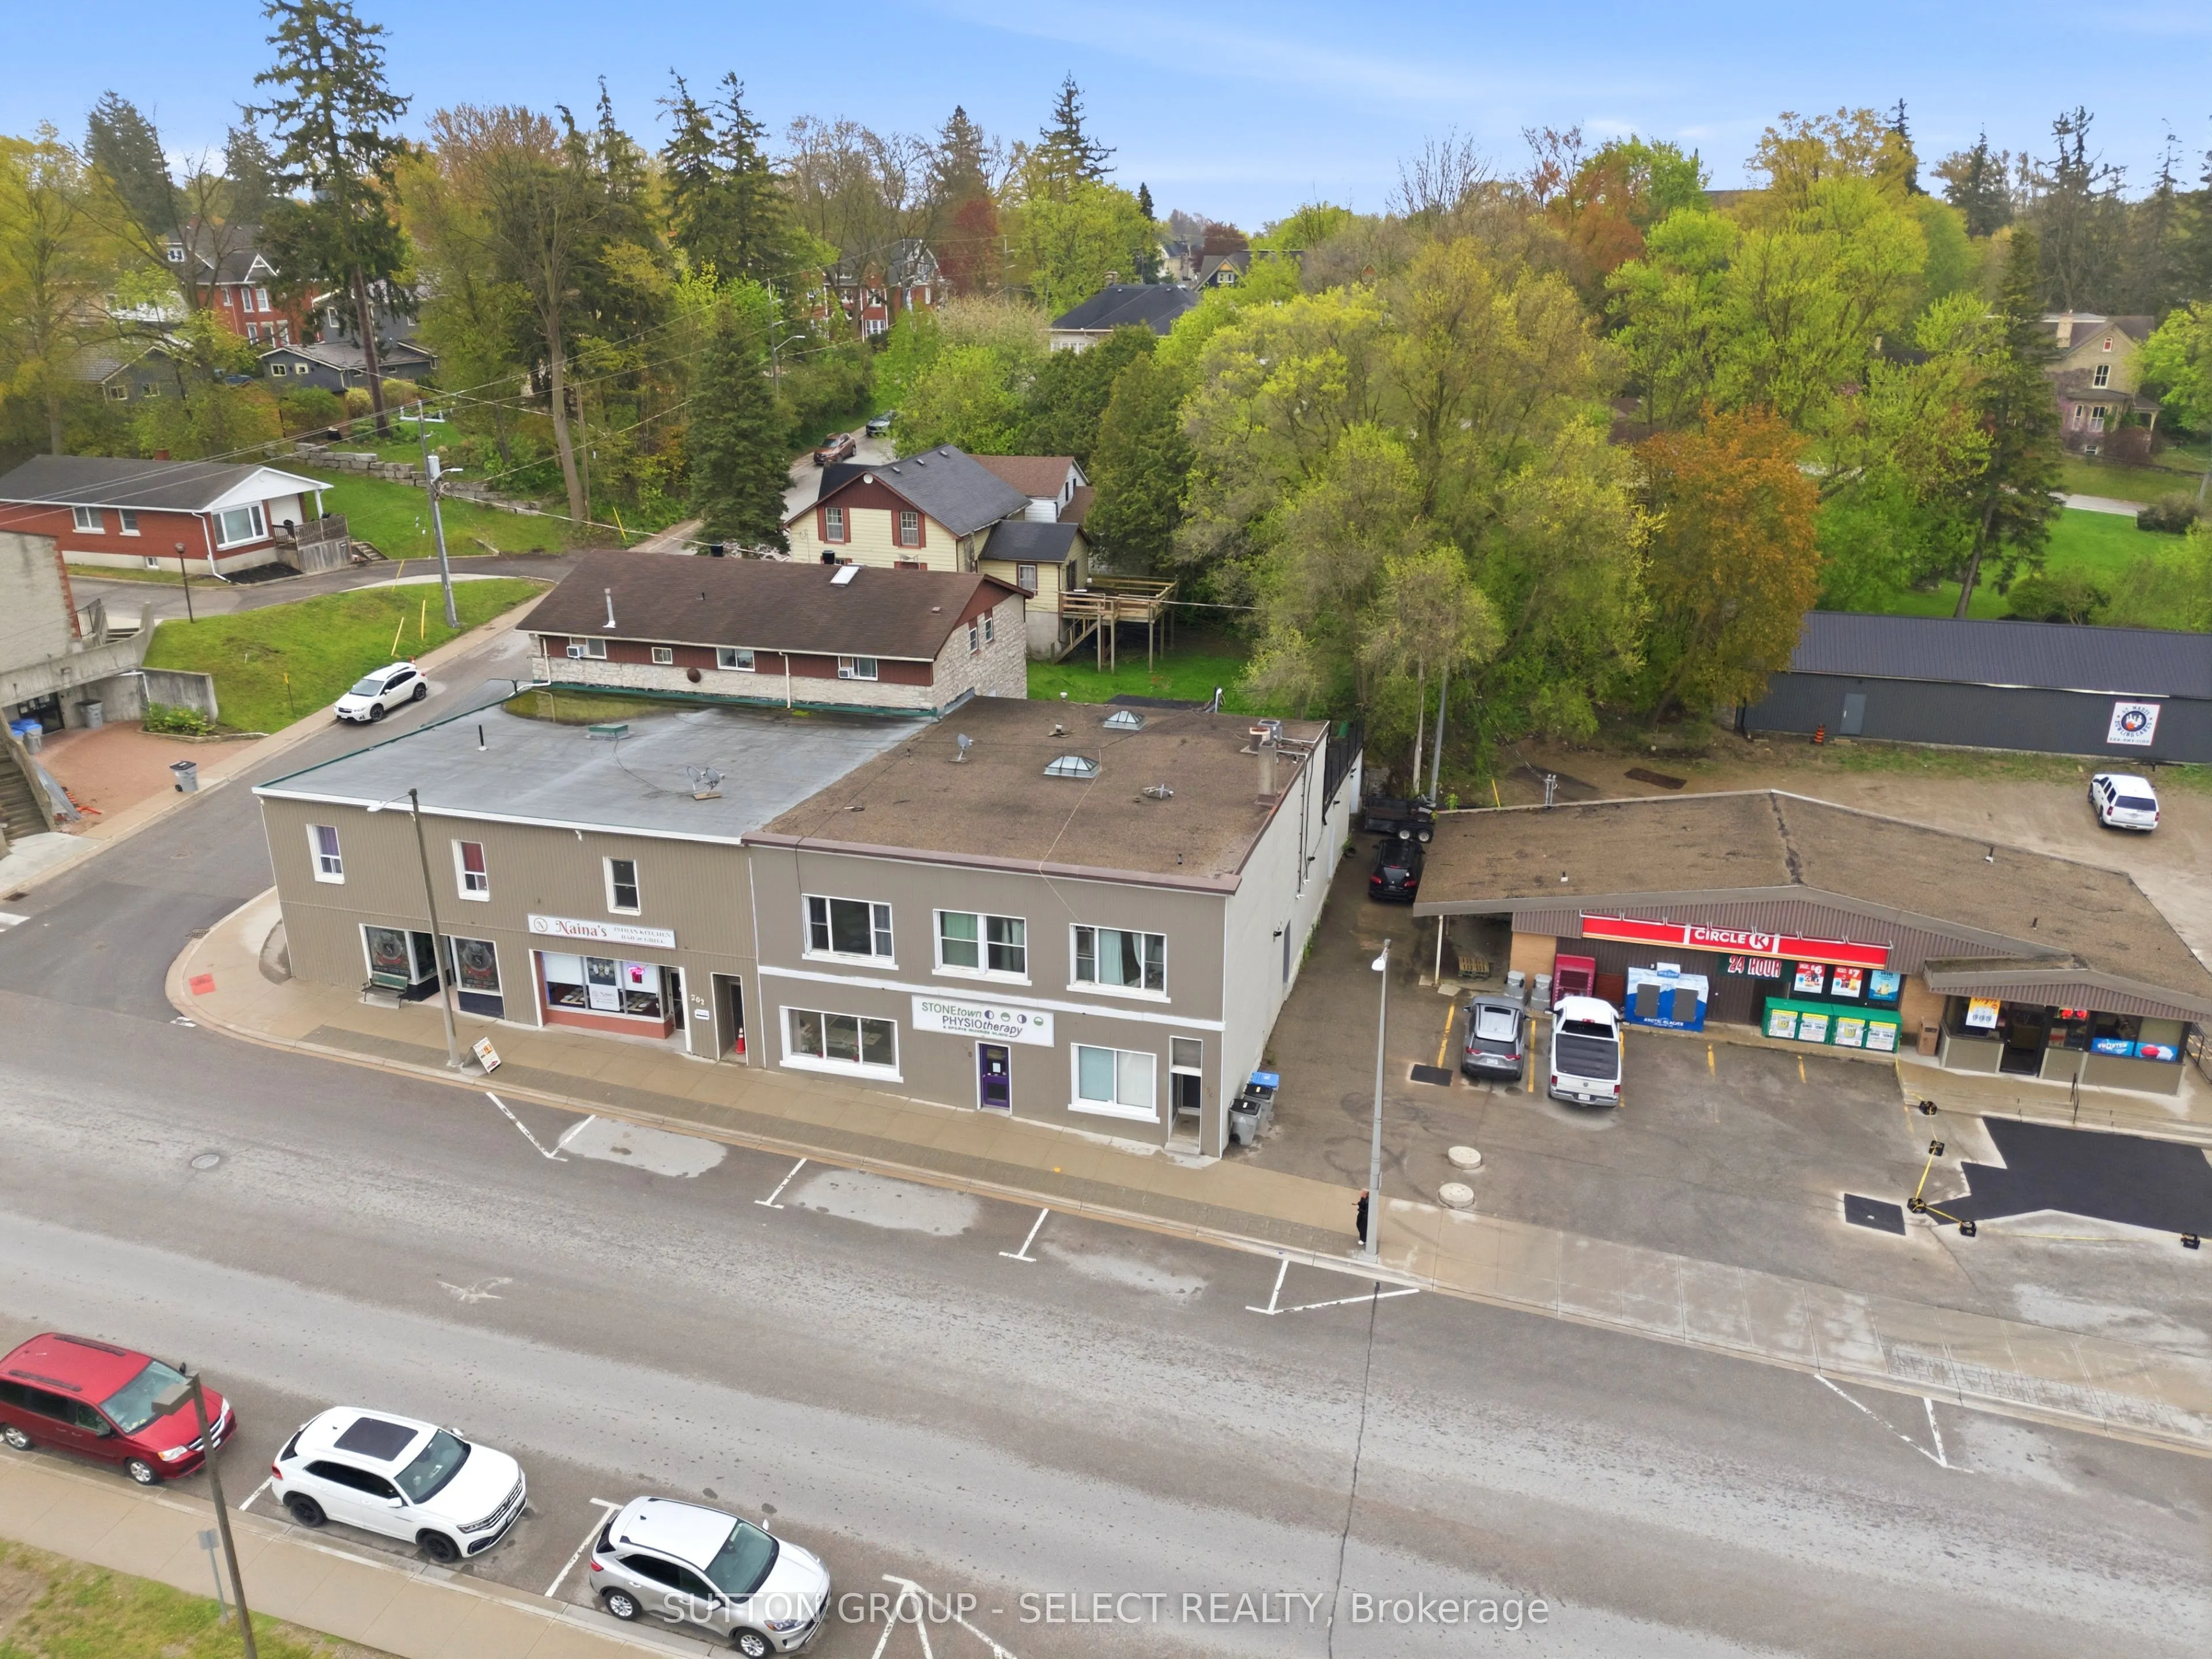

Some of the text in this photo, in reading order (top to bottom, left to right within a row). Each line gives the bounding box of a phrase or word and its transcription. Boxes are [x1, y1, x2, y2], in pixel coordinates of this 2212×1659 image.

[555, 920, 607, 937] Naina's
[639, 929, 671, 938] KITCHEN
[1694, 929, 1768, 949] CIRCLE K
[1728, 955, 1782, 978] 24 HOUR
[691, 994, 705, 1006] 202
[922, 1002, 982, 1018] STONEtown
[942, 1016, 1023, 1037] PHYSIOtherapy
